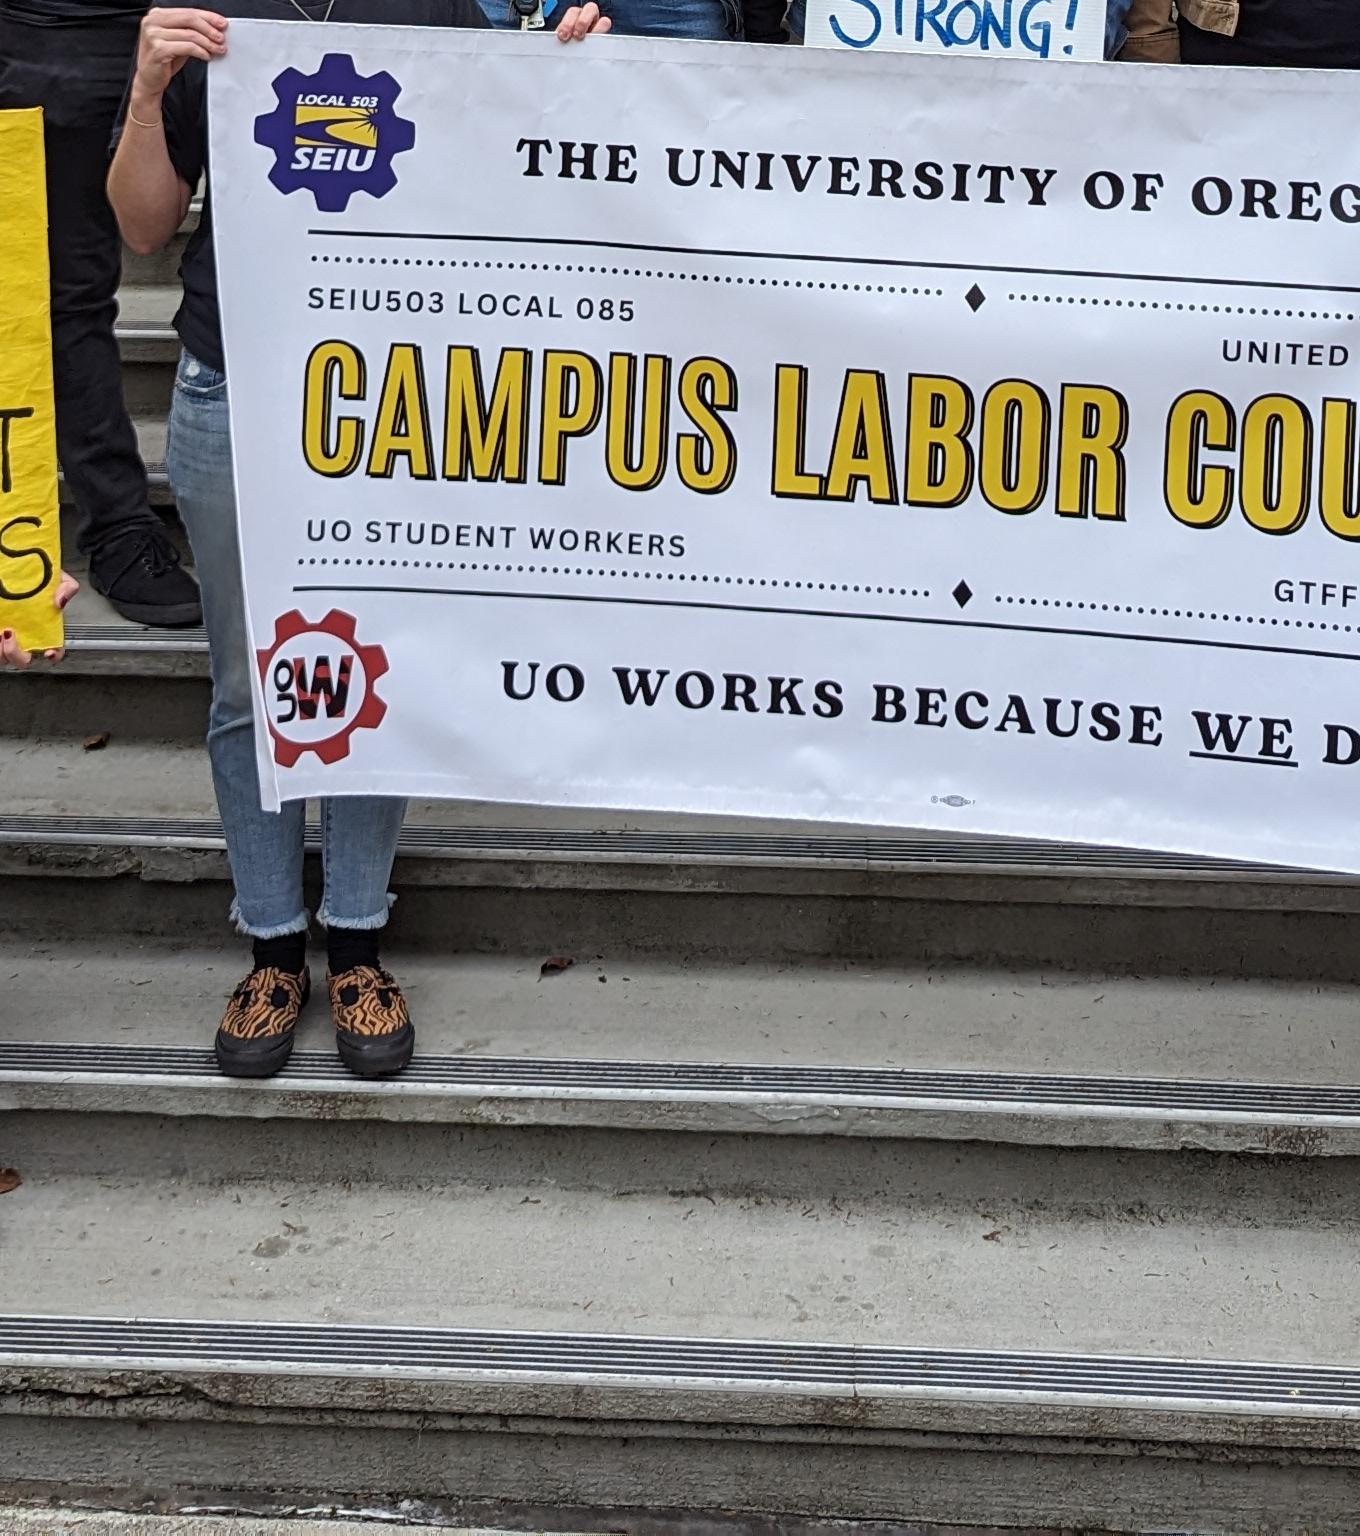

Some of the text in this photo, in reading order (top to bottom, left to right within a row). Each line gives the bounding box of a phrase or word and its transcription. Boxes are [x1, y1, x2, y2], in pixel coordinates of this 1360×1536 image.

[296, 94, 378, 107] LOCAL 503
[290, 147, 376, 172] SEIU
[516, 138, 638, 184] THE
[666, 148, 1058, 206] UNIVERSITY
[1083, 170, 1164, 212] OF
[307, 287, 636, 323] SEIU503 LOCAL 085
[1222, 339, 1350, 369] UNITED
[302, 339, 739, 495] CAMPUS
[770, 363, 1127, 523] LABOR
[307, 520, 686, 558] UO STUDENT WORKERS
[501, 660, 585, 702] UO
[613, 666, 843, 718] WORKS
[871, 683, 1164, 748] BECAUSE
[1192, 710, 1295, 758] WE
